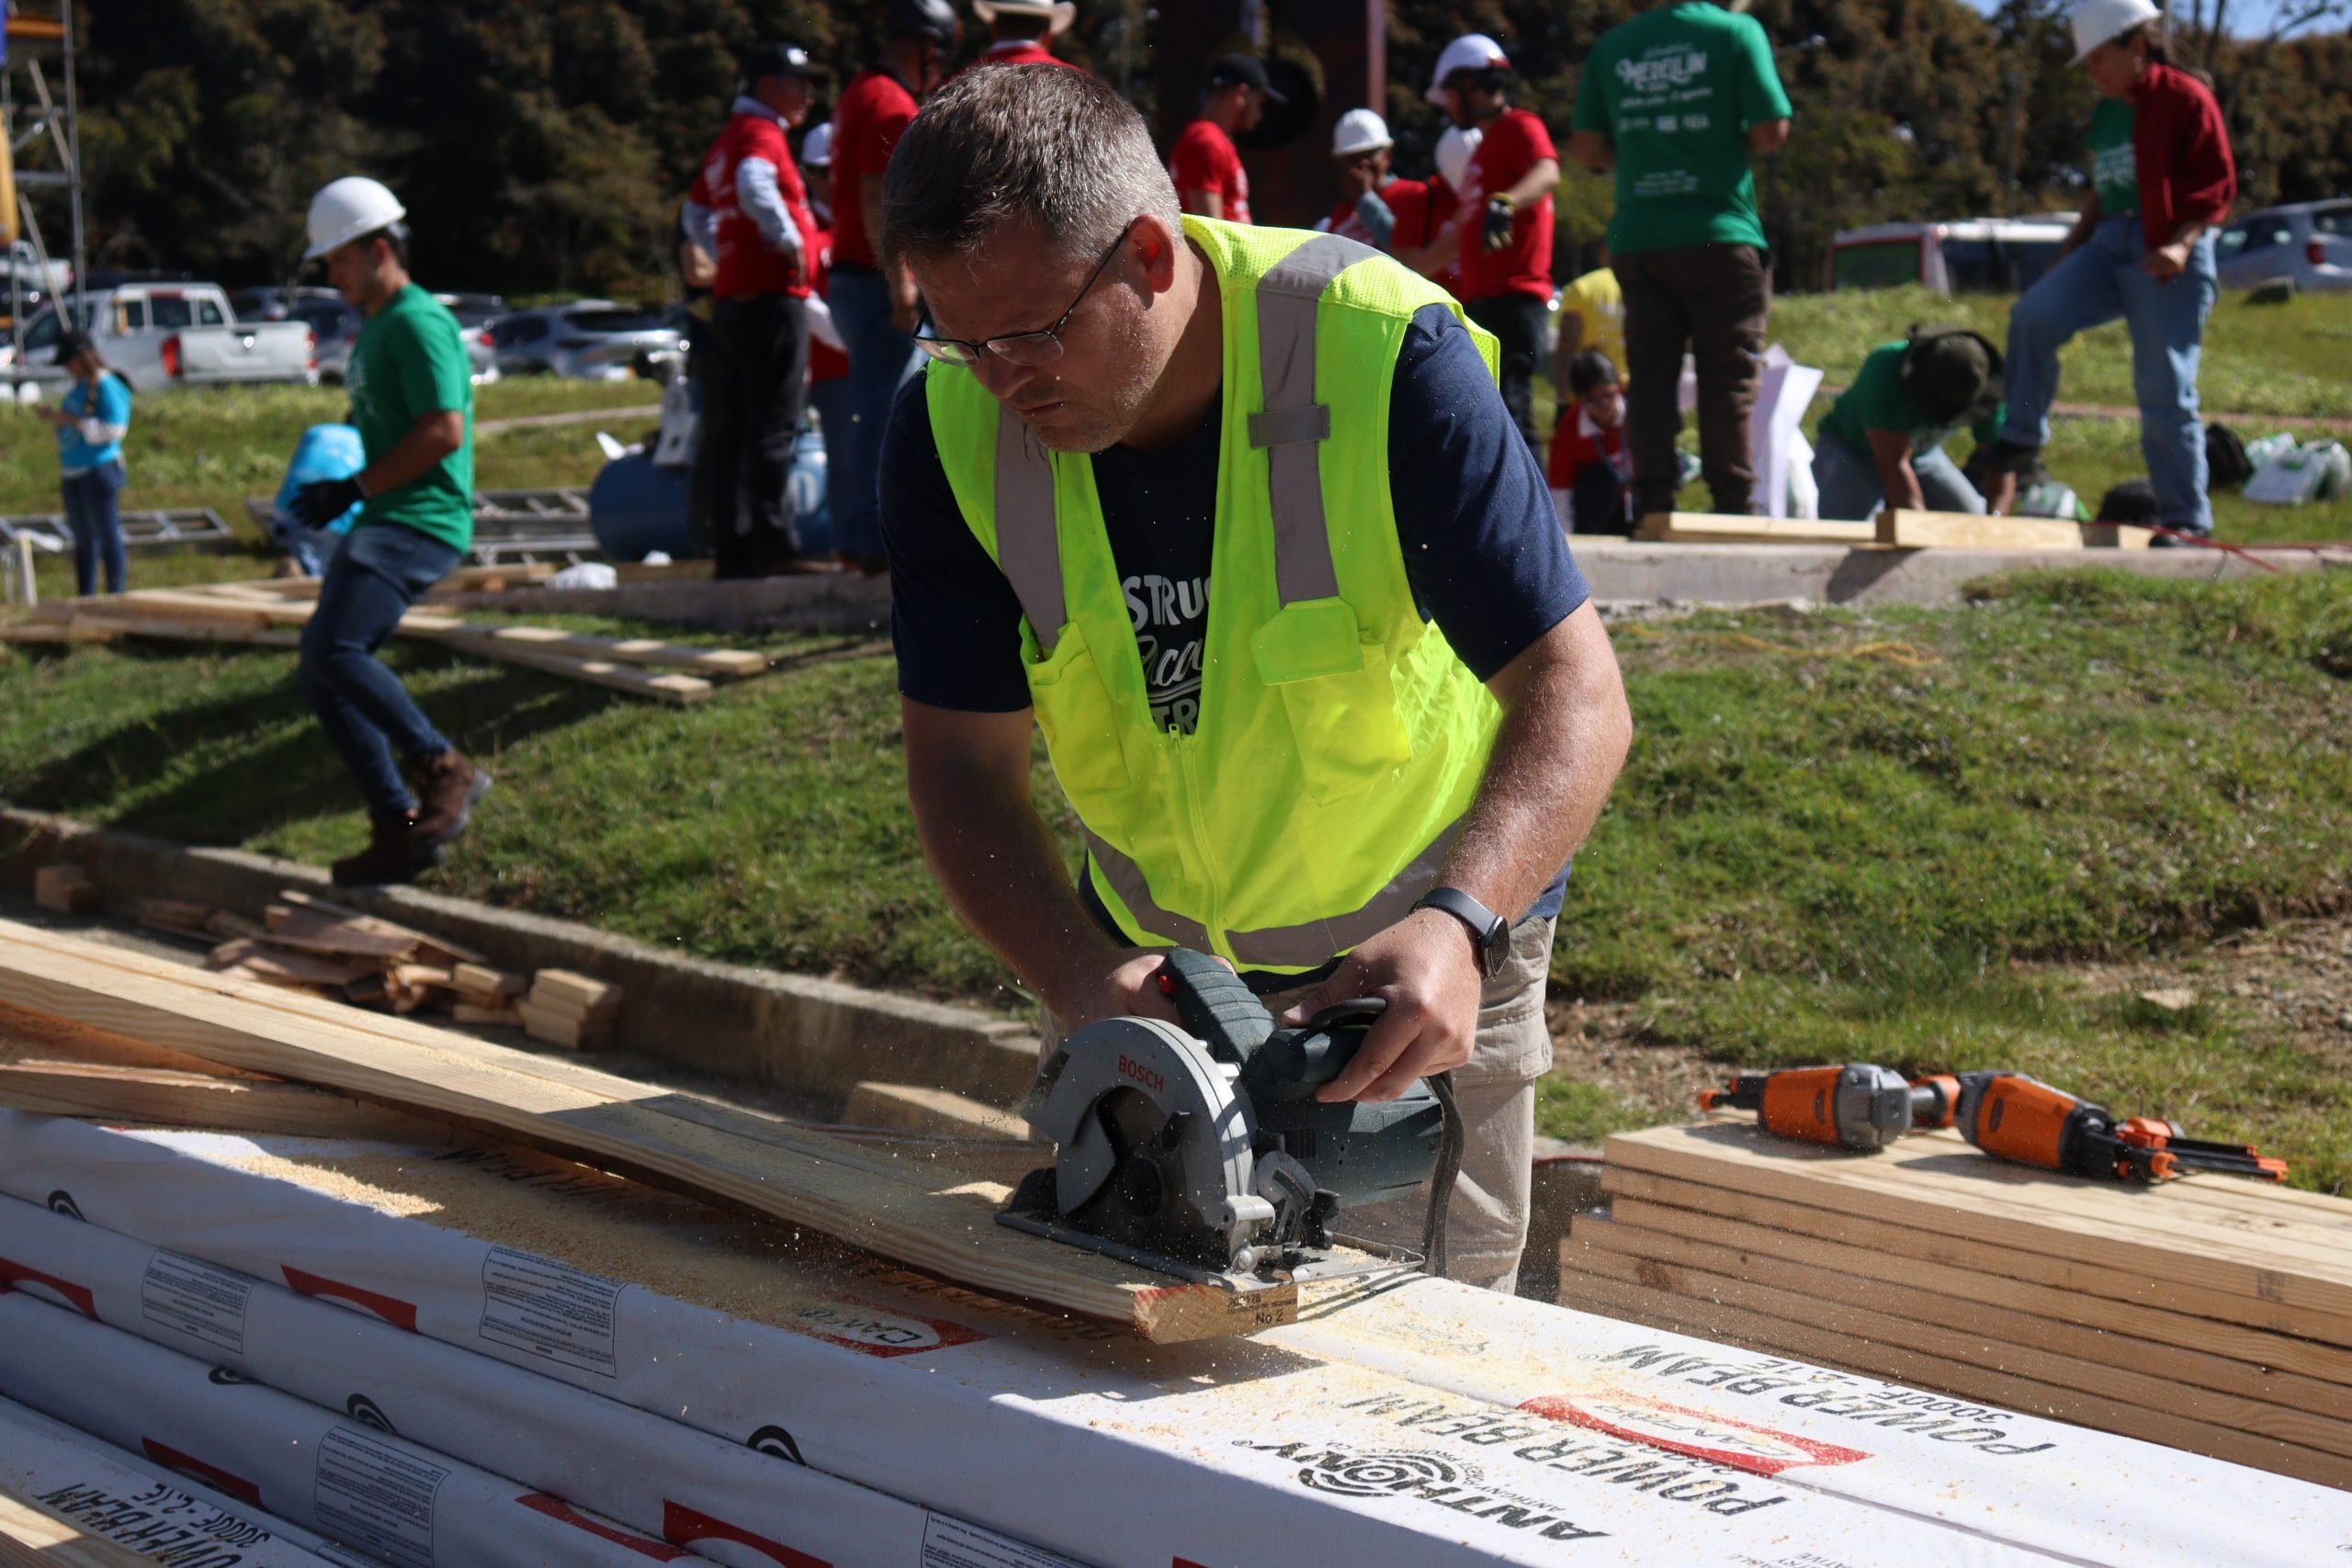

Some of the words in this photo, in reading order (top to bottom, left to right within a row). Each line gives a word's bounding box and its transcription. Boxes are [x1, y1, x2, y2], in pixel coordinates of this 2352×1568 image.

[1122, 574, 1211, 632] STRU
[1118, 1055, 1165, 1092] BOSCH
[1256, 1313, 1272, 1325] No
[1276, 1310, 1283, 1323] 2
[1600, 1344, 1805, 1395] BEAM
[1340, 1392, 1544, 1446] BEAM
[1780, 1389, 2058, 1456] POWER
[1250, 1441, 1612, 1540] ANTHONY
[1513, 1438, 1792, 1517] POWER
